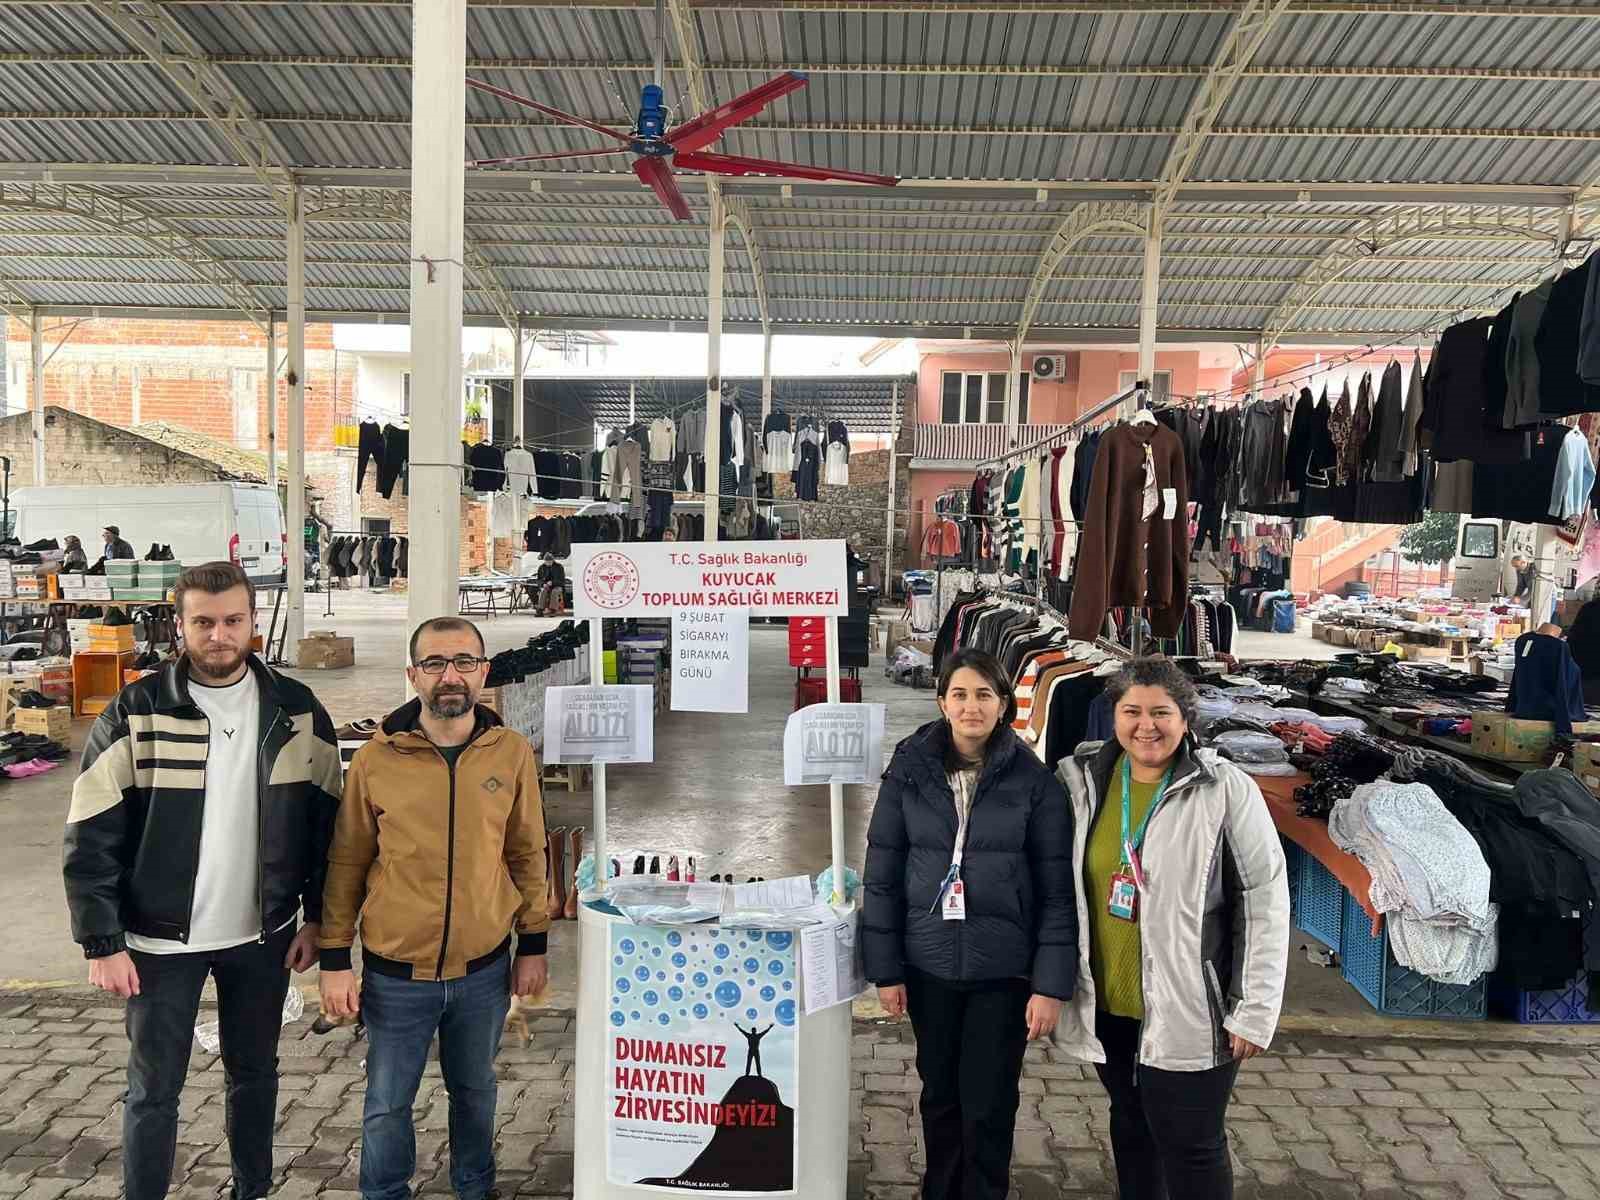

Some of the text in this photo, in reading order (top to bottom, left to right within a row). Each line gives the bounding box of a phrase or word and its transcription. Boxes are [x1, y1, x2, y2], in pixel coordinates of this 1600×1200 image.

[669, 551, 808, 567] T.C. Sağlık Bakanlığı
[702, 572, 776, 586] KUYUCAK
[642, 588, 839, 606] TOPLUM SAĞLIĞI MERKEZİ
[680, 611, 726, 624] 9 ŞUBAT
[680, 629, 729, 641] SİGARAYI
[680, 649, 730, 661] BIRAKMA
[680, 666, 712, 679] GÜNÜ
[563, 712, 629, 737] ALO 171
[615, 1037, 727, 1068] DUMANSIZ
[615, 1066, 705, 1096] HAYATIN
[614, 1092, 777, 1127] ZİRVESİNDEYİZ!
